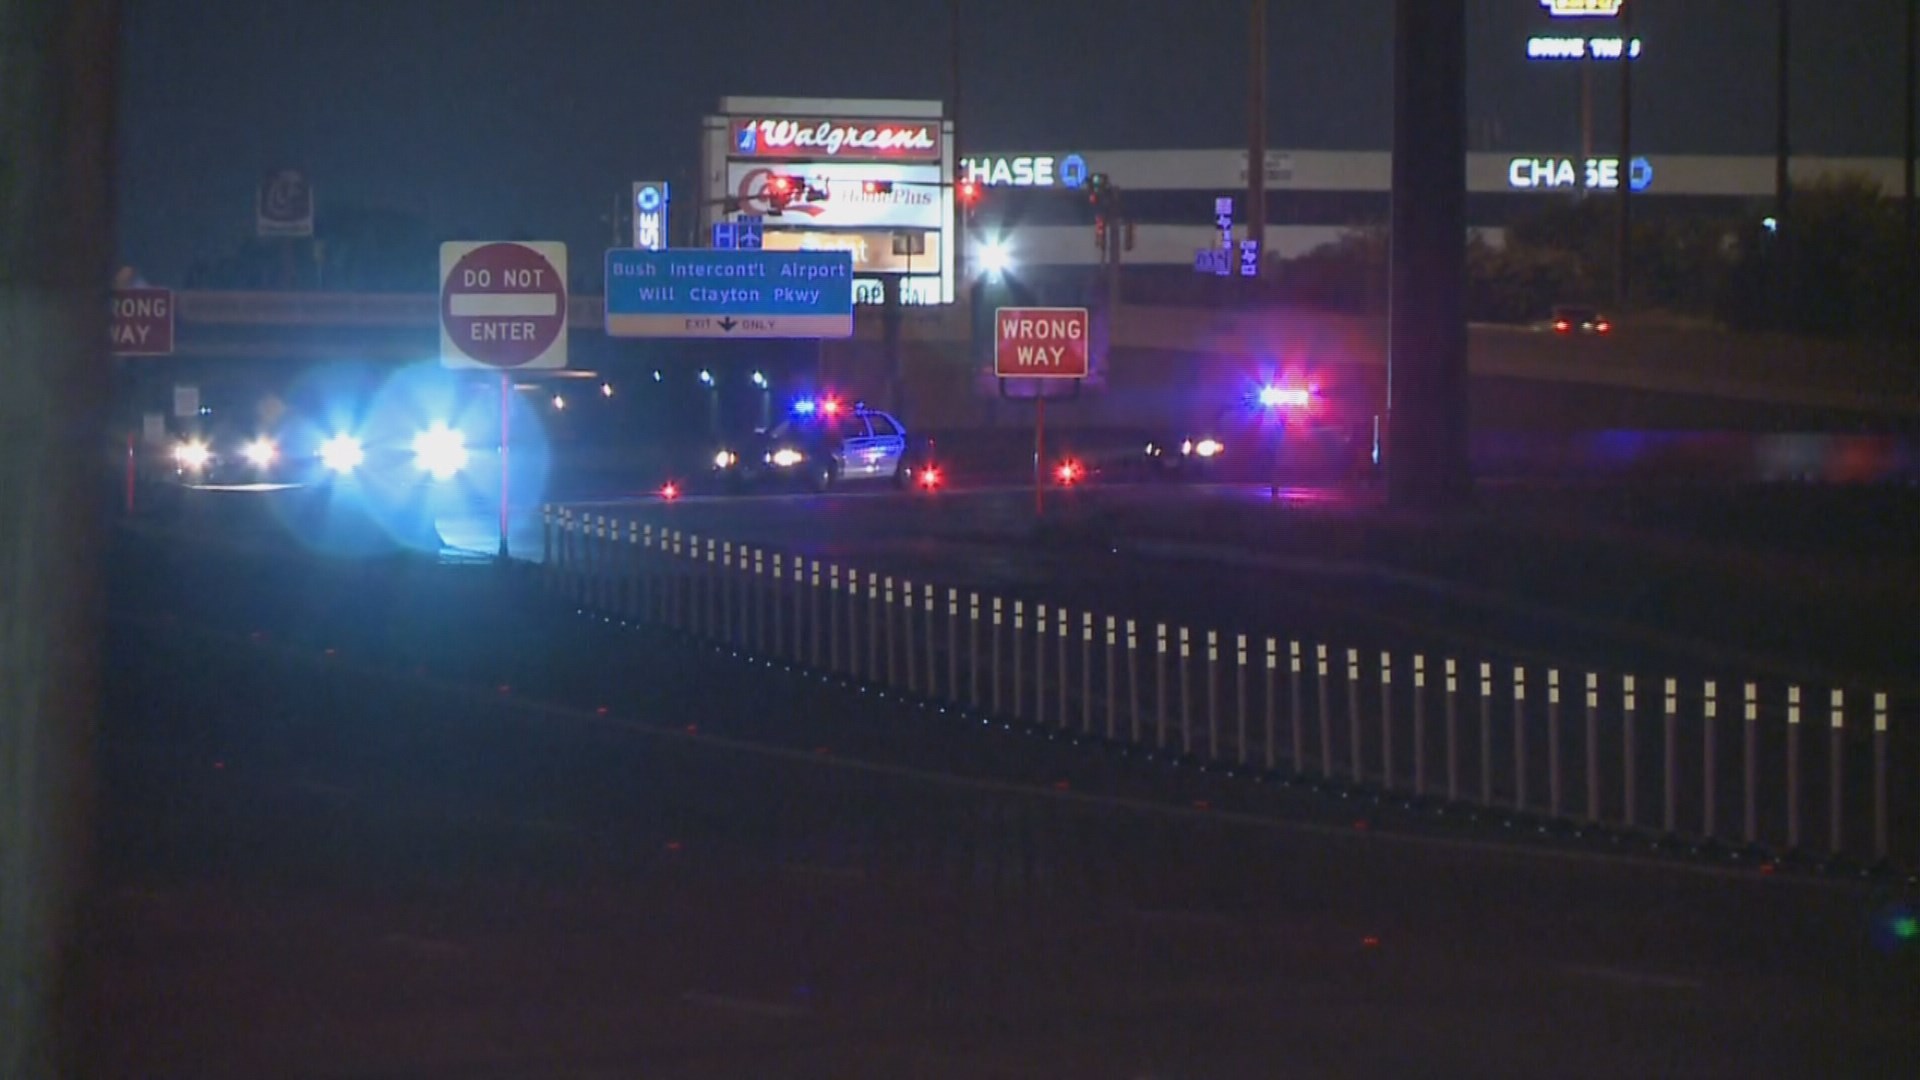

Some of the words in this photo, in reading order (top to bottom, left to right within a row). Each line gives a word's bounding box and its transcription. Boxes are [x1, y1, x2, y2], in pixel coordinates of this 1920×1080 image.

[760, 119, 934, 155] Walgreens
[959, 156, 1054, 186] HASE
[1509, 158, 1619, 187] CHASE
[463, 269, 492, 287] DO
[503, 269, 544, 287] NOT
[612, 262, 656, 277] Bush
[670, 262, 766, 277] Intercont'l
[780, 262, 845, 280] Airport
[638, 287, 674, 301] Will
[689, 287, 760, 305] Clayton
[774, 287, 820, 305] Pkwy
[470, 322, 536, 341] ENTER
[685, 319, 711, 330] EXIT
[741, 319, 776, 330] ONLY
[1002, 319, 1081, 340] WRONG
[1017, 346, 1065, 366] WAY
